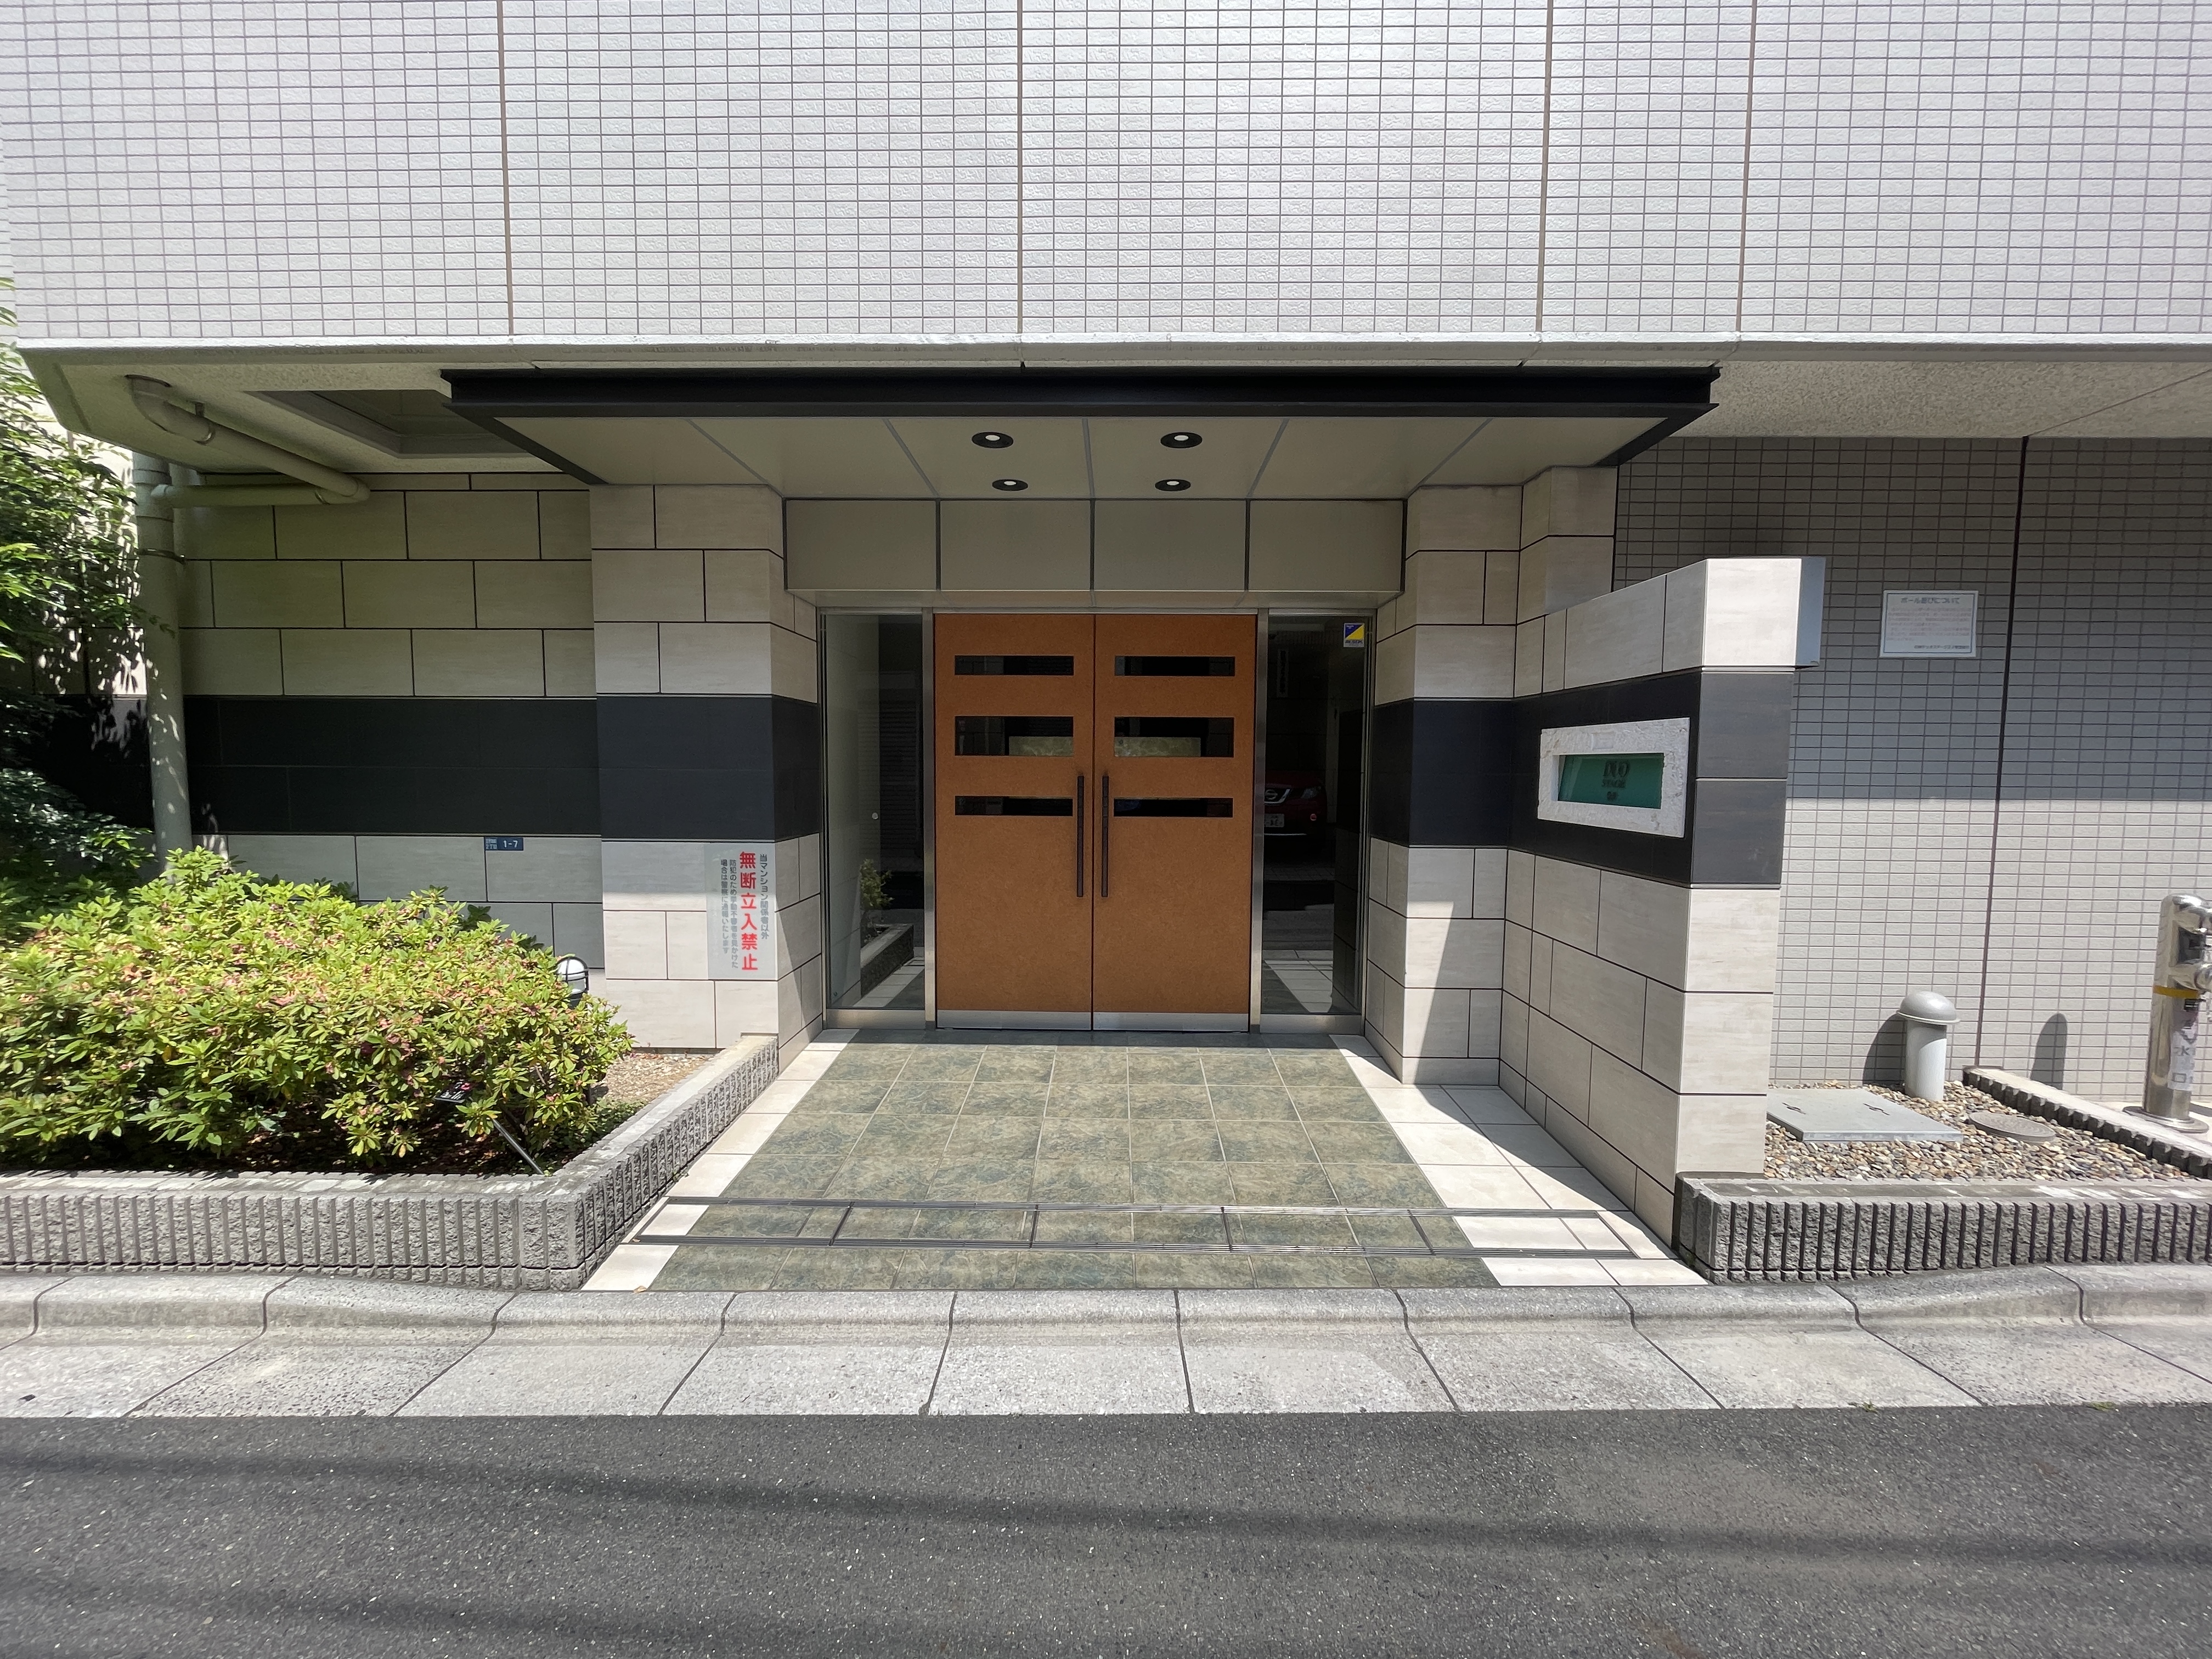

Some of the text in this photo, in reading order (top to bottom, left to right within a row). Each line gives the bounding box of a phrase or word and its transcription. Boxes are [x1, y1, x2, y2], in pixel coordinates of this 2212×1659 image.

[503, 840, 518, 848] 1-7
[739, 851, 758, 970] 無断立入禁止
